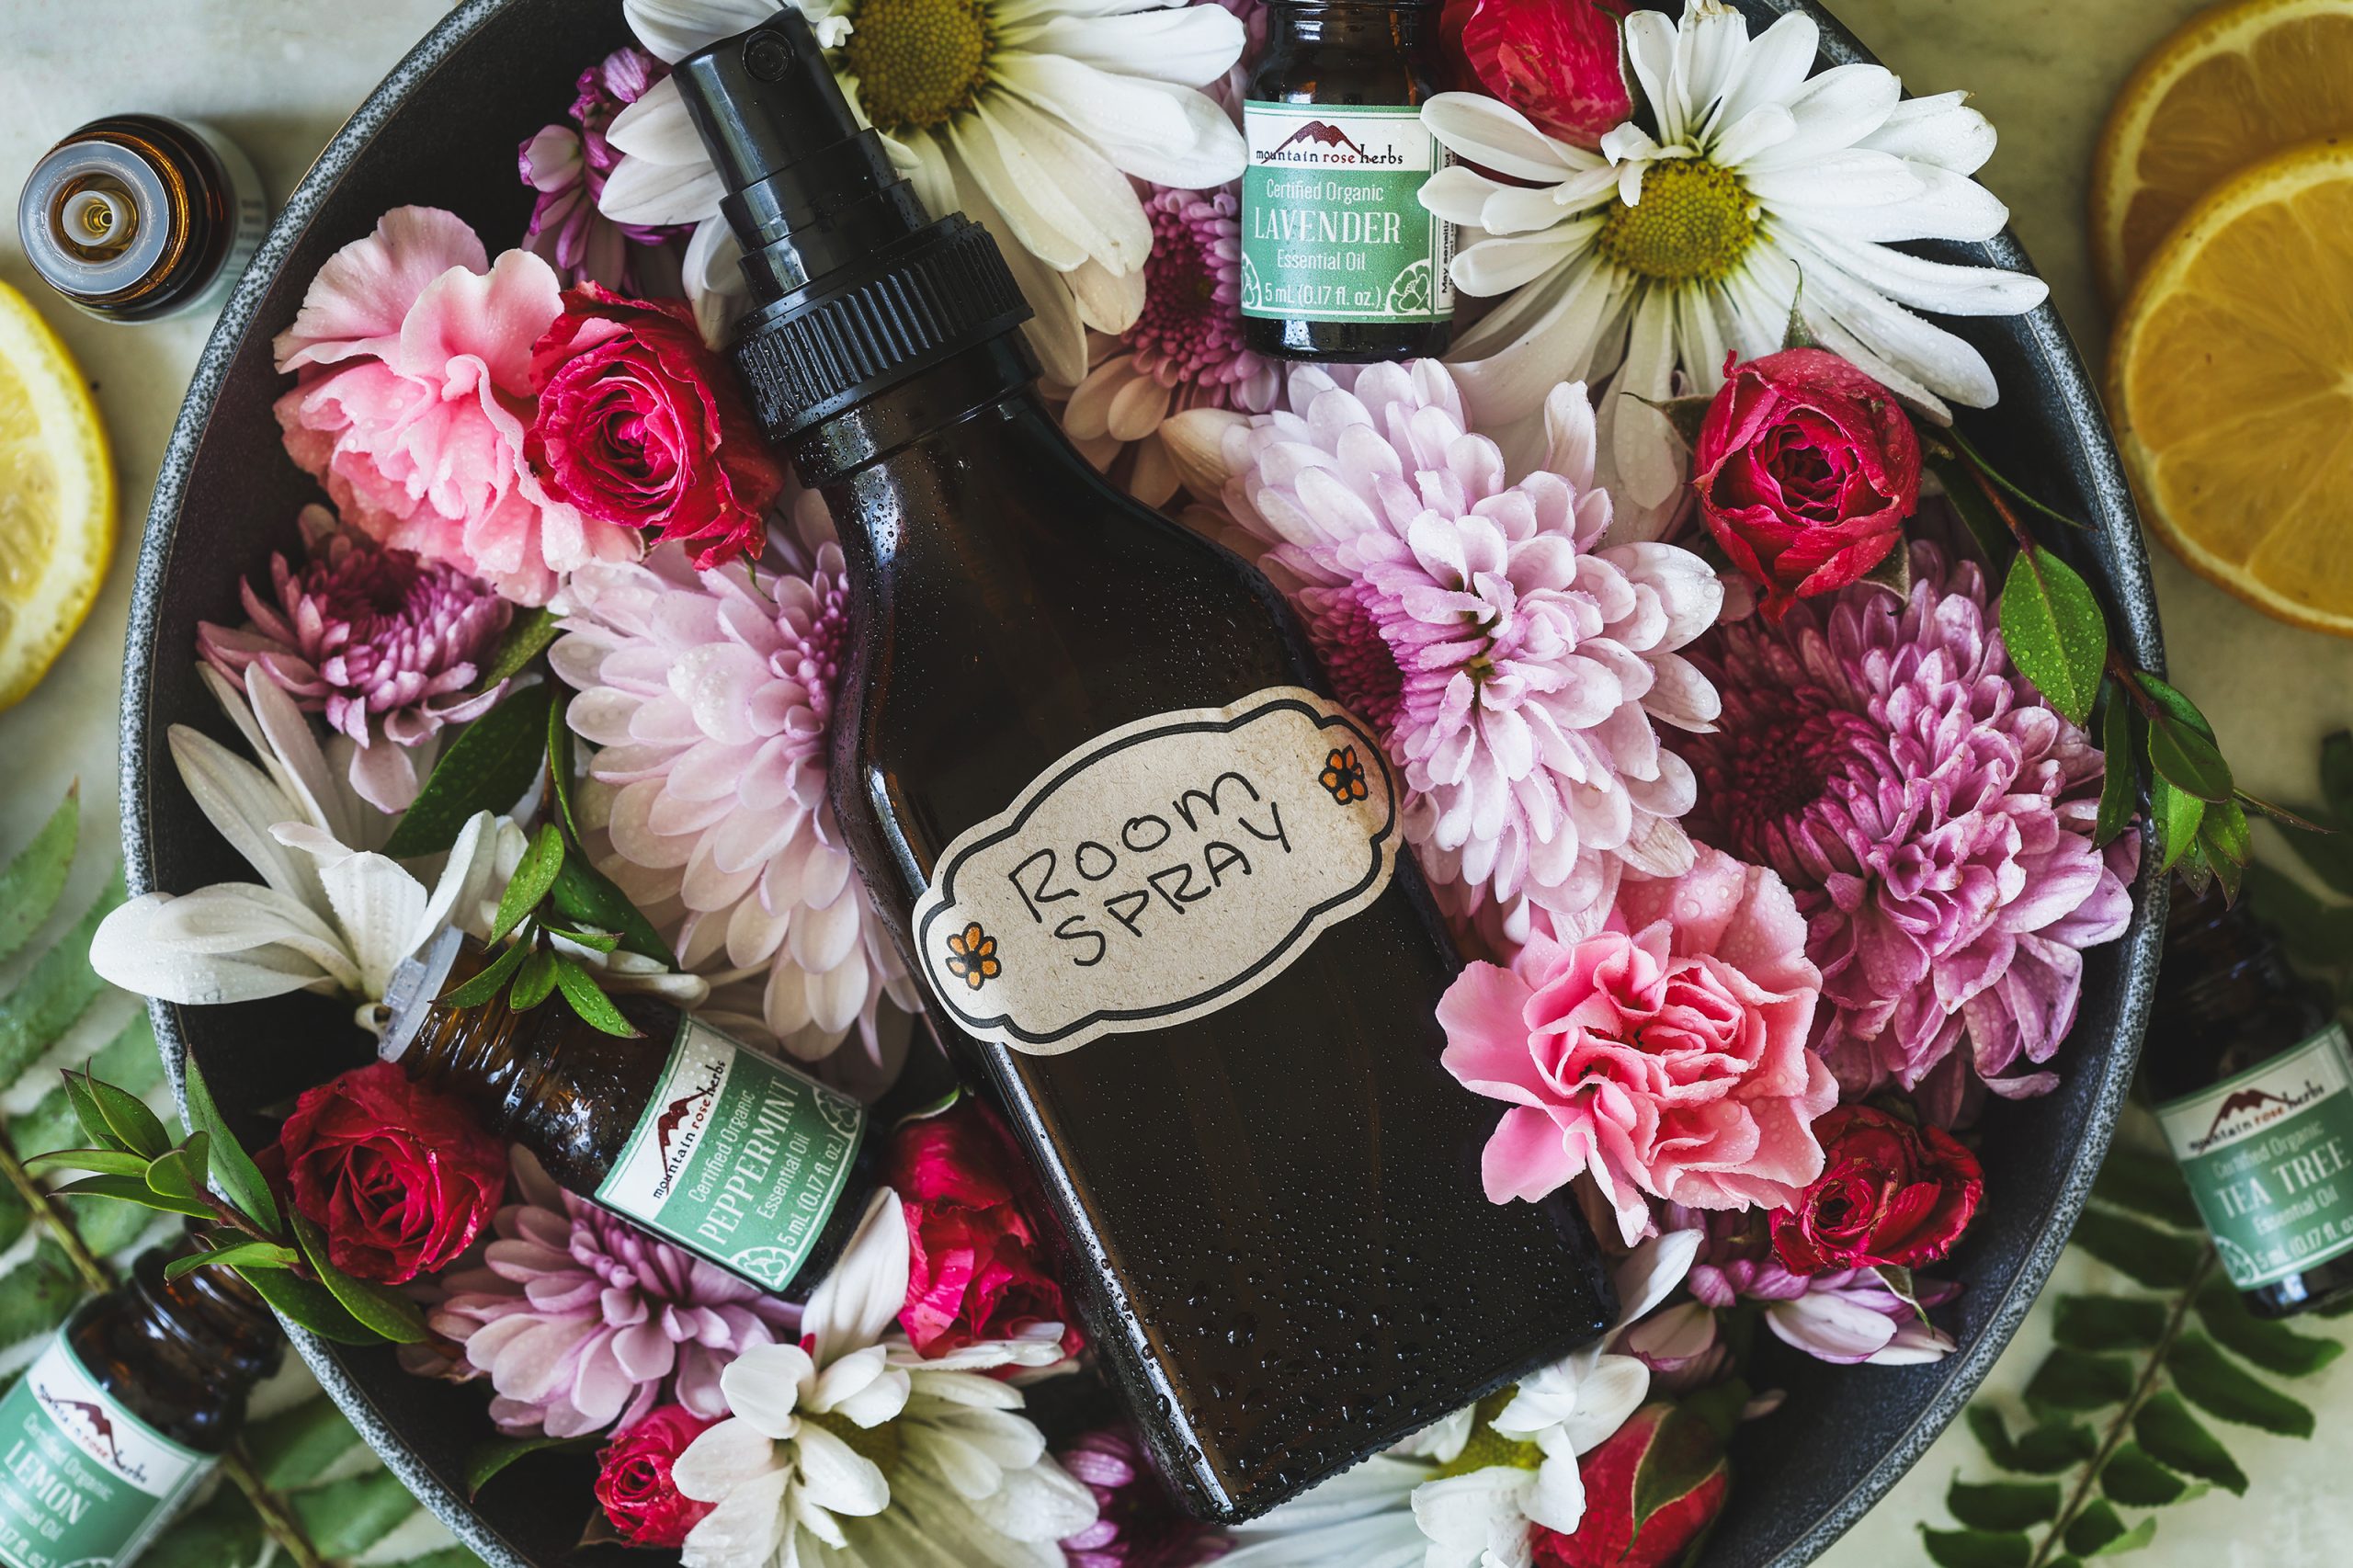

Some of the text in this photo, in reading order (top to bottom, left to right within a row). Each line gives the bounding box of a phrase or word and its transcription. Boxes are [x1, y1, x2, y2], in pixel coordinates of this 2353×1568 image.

[1256, 143, 1404, 165] mountain rose herbs
[1267, 178, 1384, 205] Certified Organic
[1254, 207, 1402, 244] LAVENDER
[1278, 249, 1366, 271] Essential Oil
[1265, 282, 1381, 309] 5 mL (0.17 fl. oz.)
[1441, 267, 1449, 293] May
[1008, 770, 1260, 925] ROOM
[1053, 801, 1292, 967] SPRAY
[2254, 1105, 2286, 1126] rose
[2282, 1080, 2325, 1111] herbs
[653, 1060, 726, 1199] mountain rose herbs
[688, 1089, 756, 1203] Certified Organic
[697, 1076, 799, 1245] PEPPERMINT
[2211, 1119, 2325, 1179] Certified Organic
[756, 1132, 812, 1221] Essential Oil
[814, 1158, 833, 1179] fl.
[2213, 1136, 2352, 1219] TEA TREE
[796, 1176, 824, 1213] (0.17
[2252, 1184, 2339, 1236] Essential Oil
[778, 1232, 796, 1247] 5
[788, 1209, 811, 1240] mL
[2254, 1250, 2268, 1270] 5
[4, 1438, 91, 1525] LEMON
[40, 1517, 65, 1544] Oil
